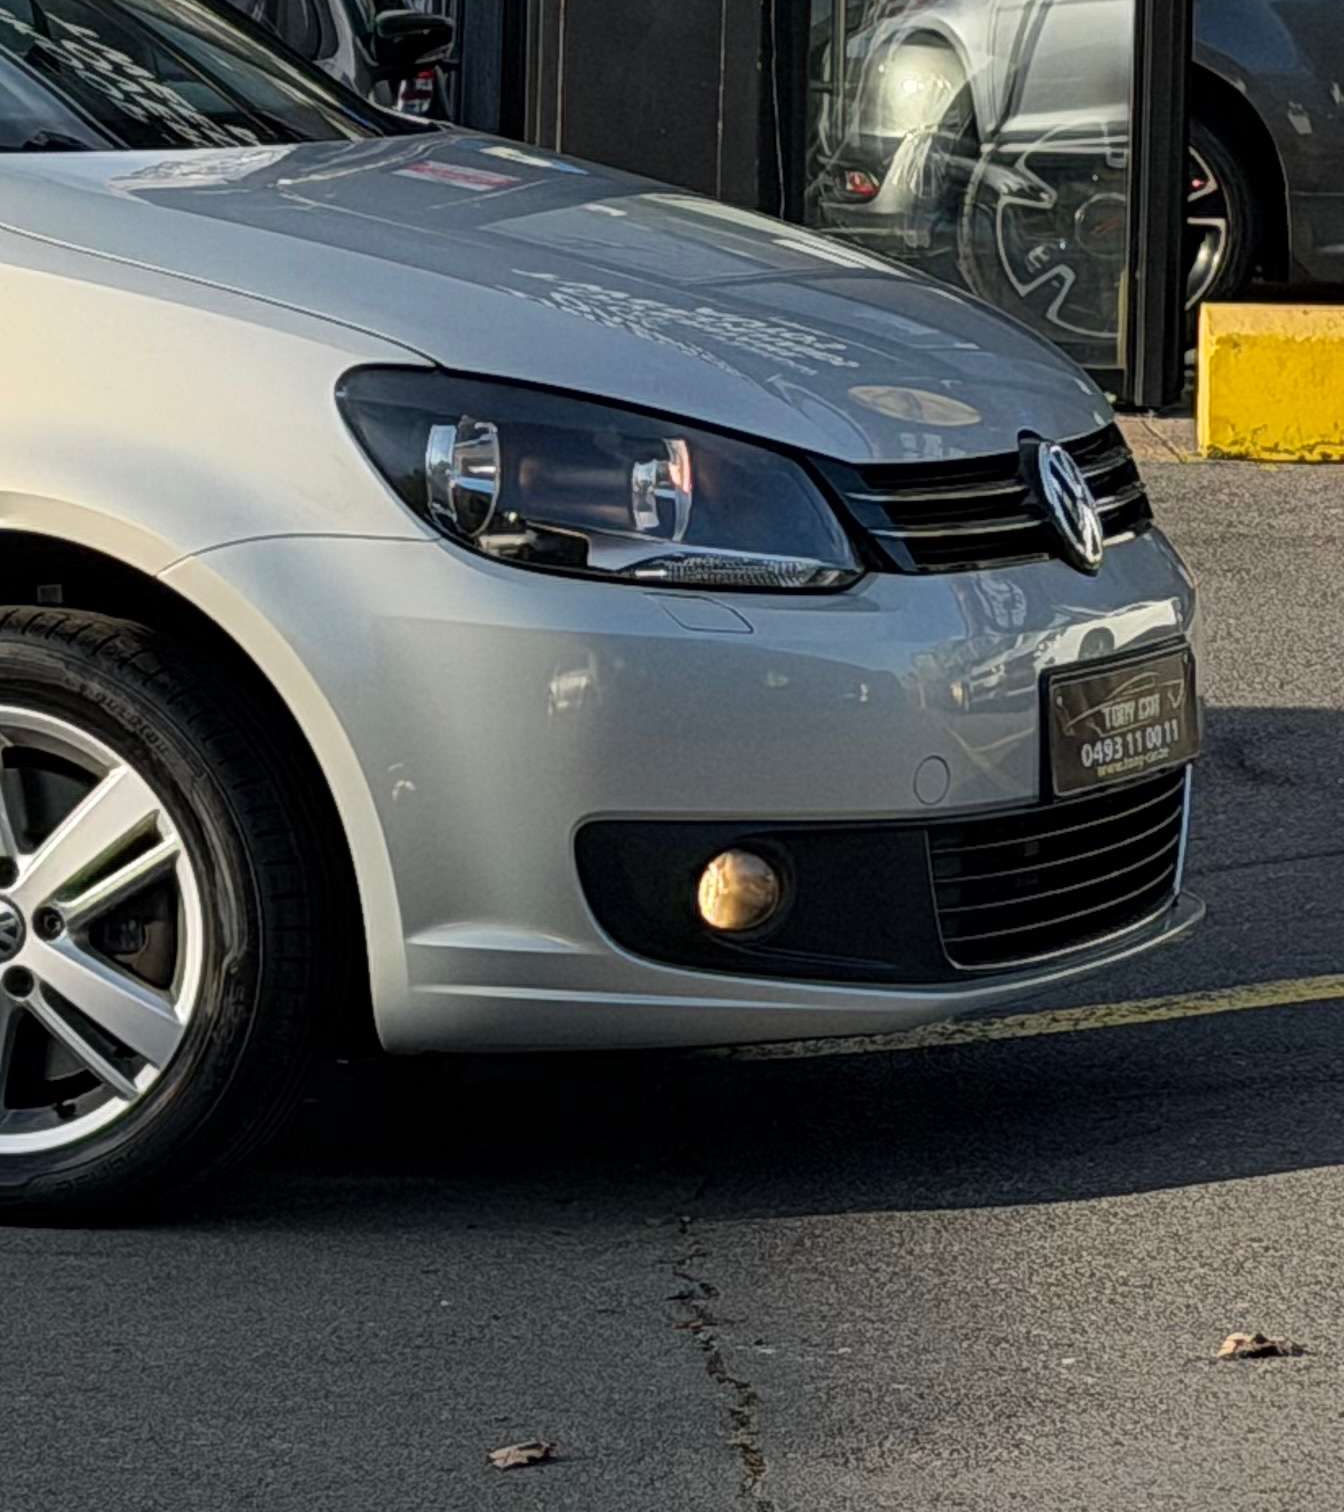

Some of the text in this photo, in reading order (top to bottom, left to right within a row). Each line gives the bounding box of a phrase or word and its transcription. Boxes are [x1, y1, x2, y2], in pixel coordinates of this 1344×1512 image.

[1081, 718, 1179, 768] 0493 11 00 11
